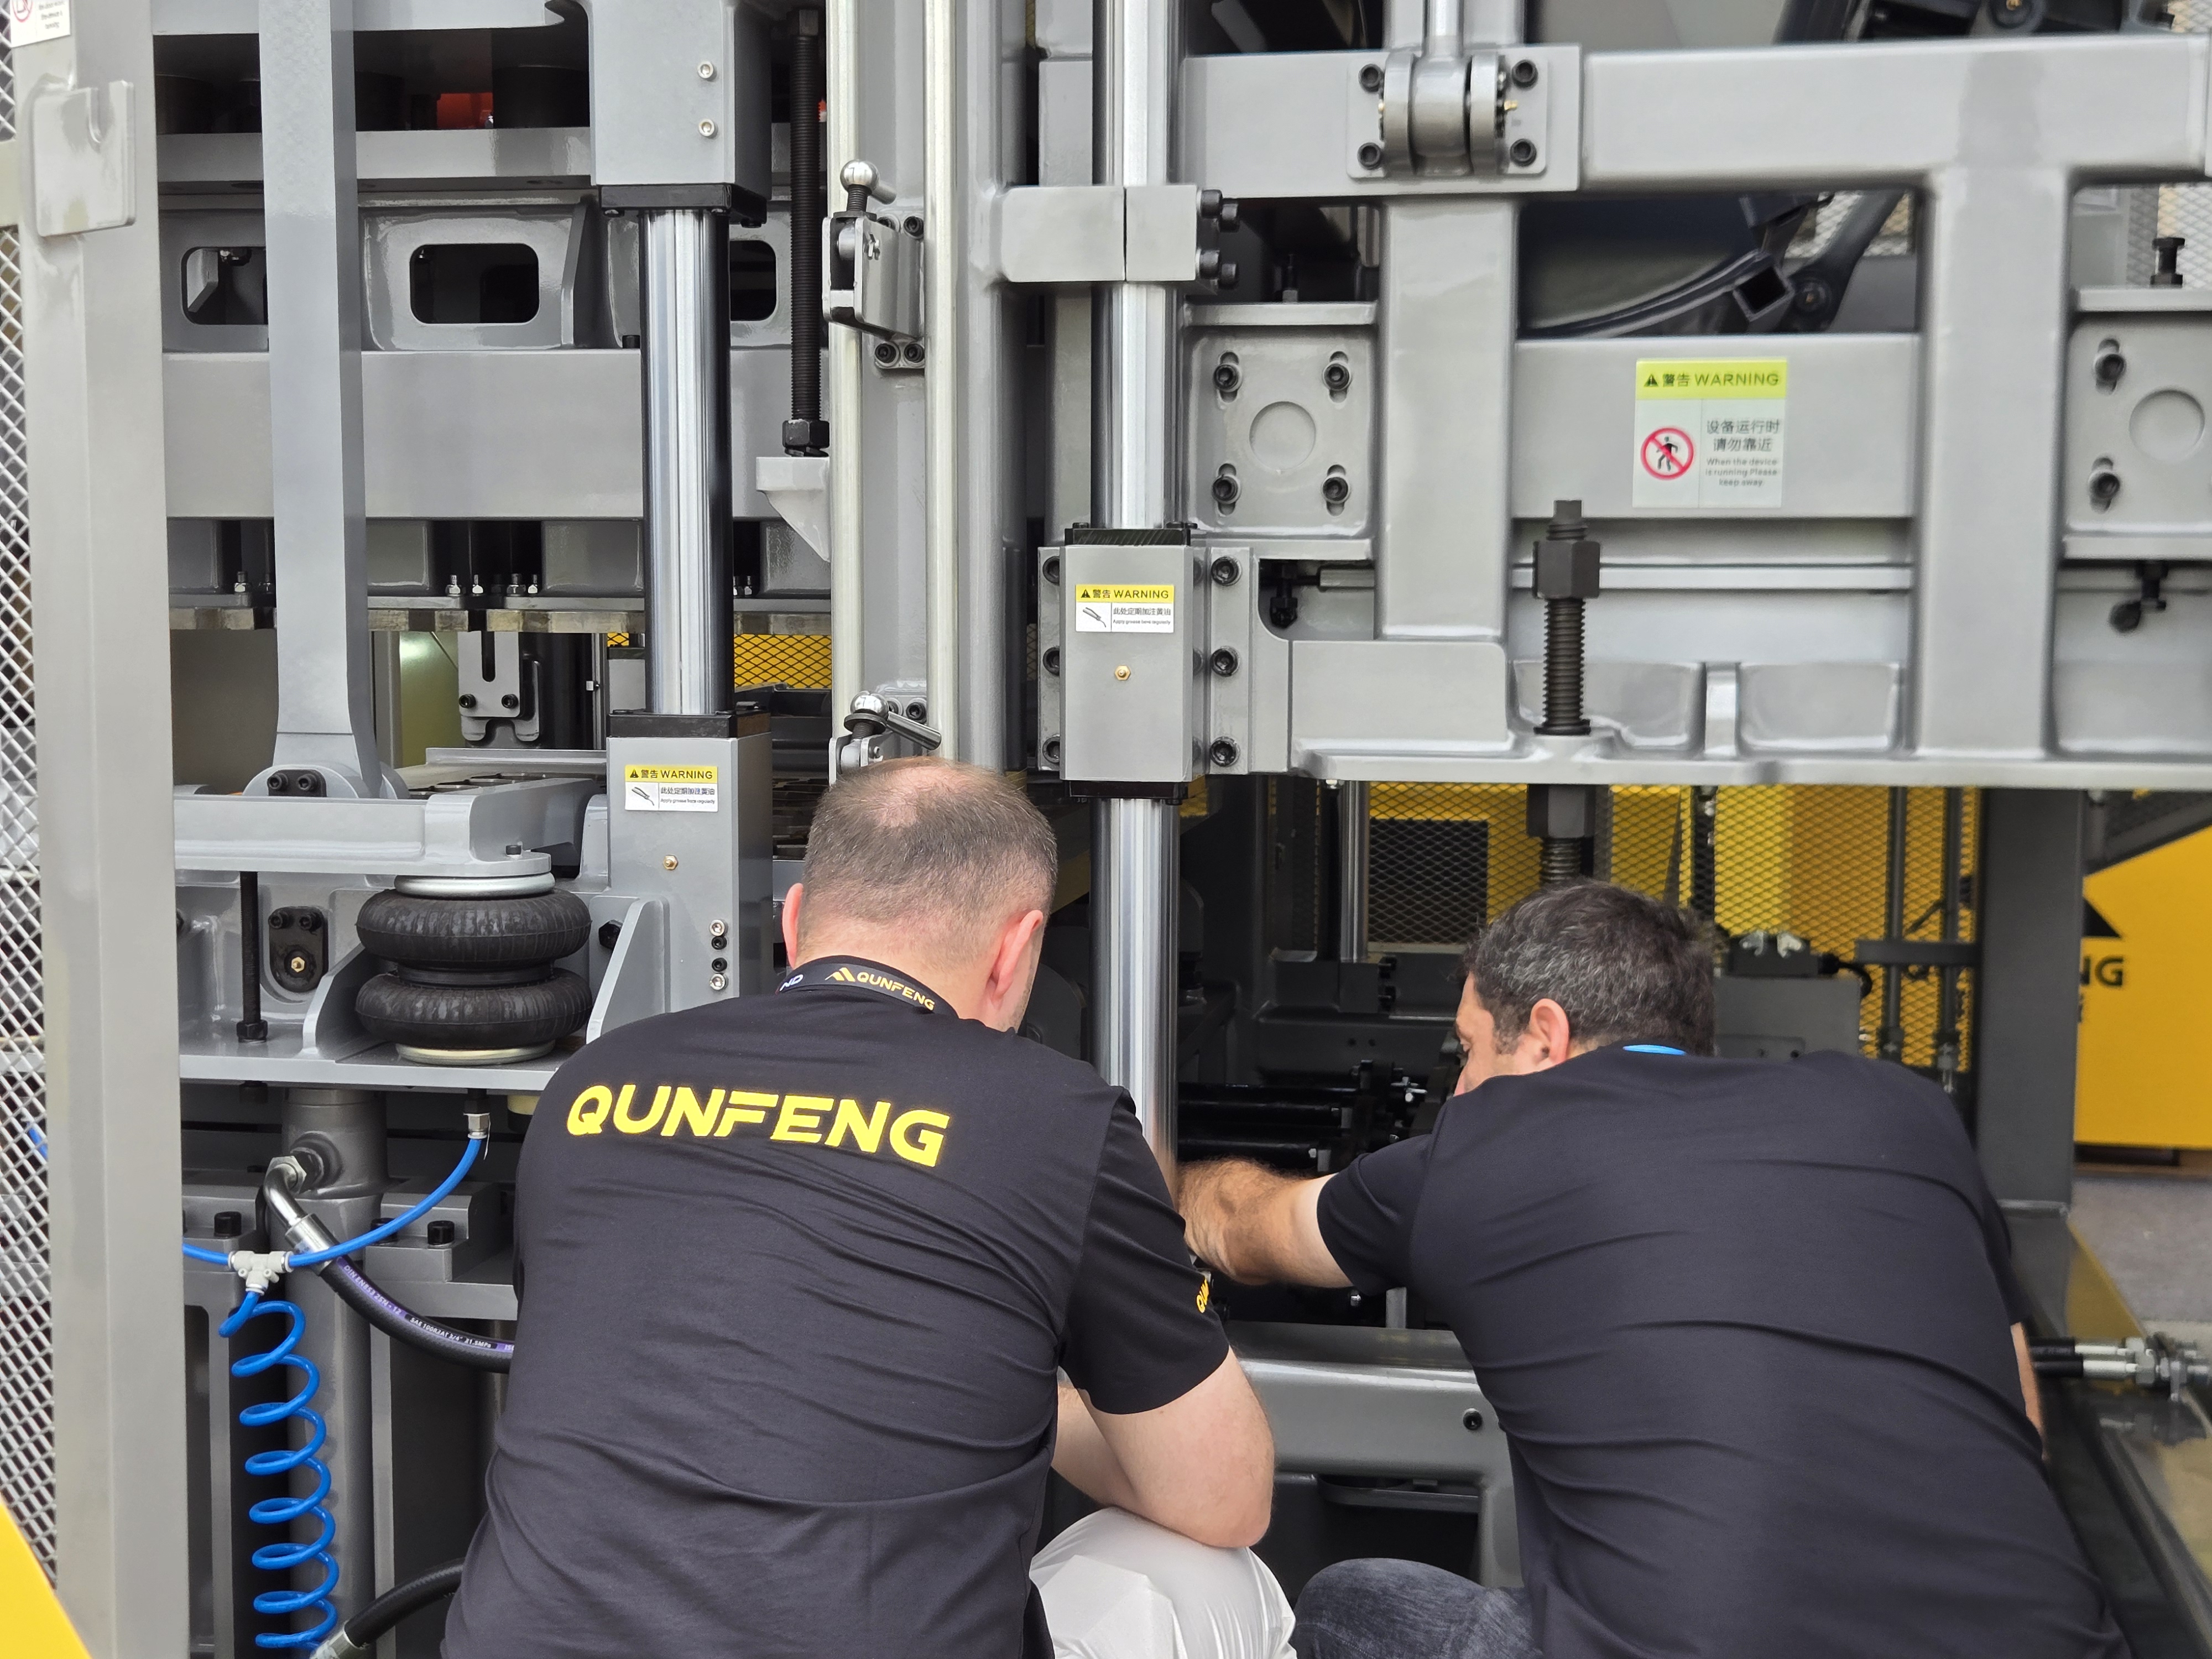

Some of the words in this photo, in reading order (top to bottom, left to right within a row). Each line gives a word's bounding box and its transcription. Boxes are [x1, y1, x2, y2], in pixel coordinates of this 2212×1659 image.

[1662, 373, 1690, 387] 警告
[1695, 373, 1779, 387] WARNING
[1707, 419, 1780, 434] 设备运行时
[1713, 437, 1772, 452] 请勿靠近
[1714, 468, 1747, 478] running
[1719, 478, 1740, 487] keep
[1741, 479, 1763, 488] away
[1093, 589, 1110, 598] 警告
[1114, 589, 1168, 598] WARNING
[641, 769, 658, 779] 警告
[660, 770, 712, 779] WARNING
[857, 972, 935, 1011] QUNFENG
[566, 1084, 950, 1167] QUNFENG
[343, 1265, 357, 1279] DIN
[393, 1307, 401, 1315] 12
